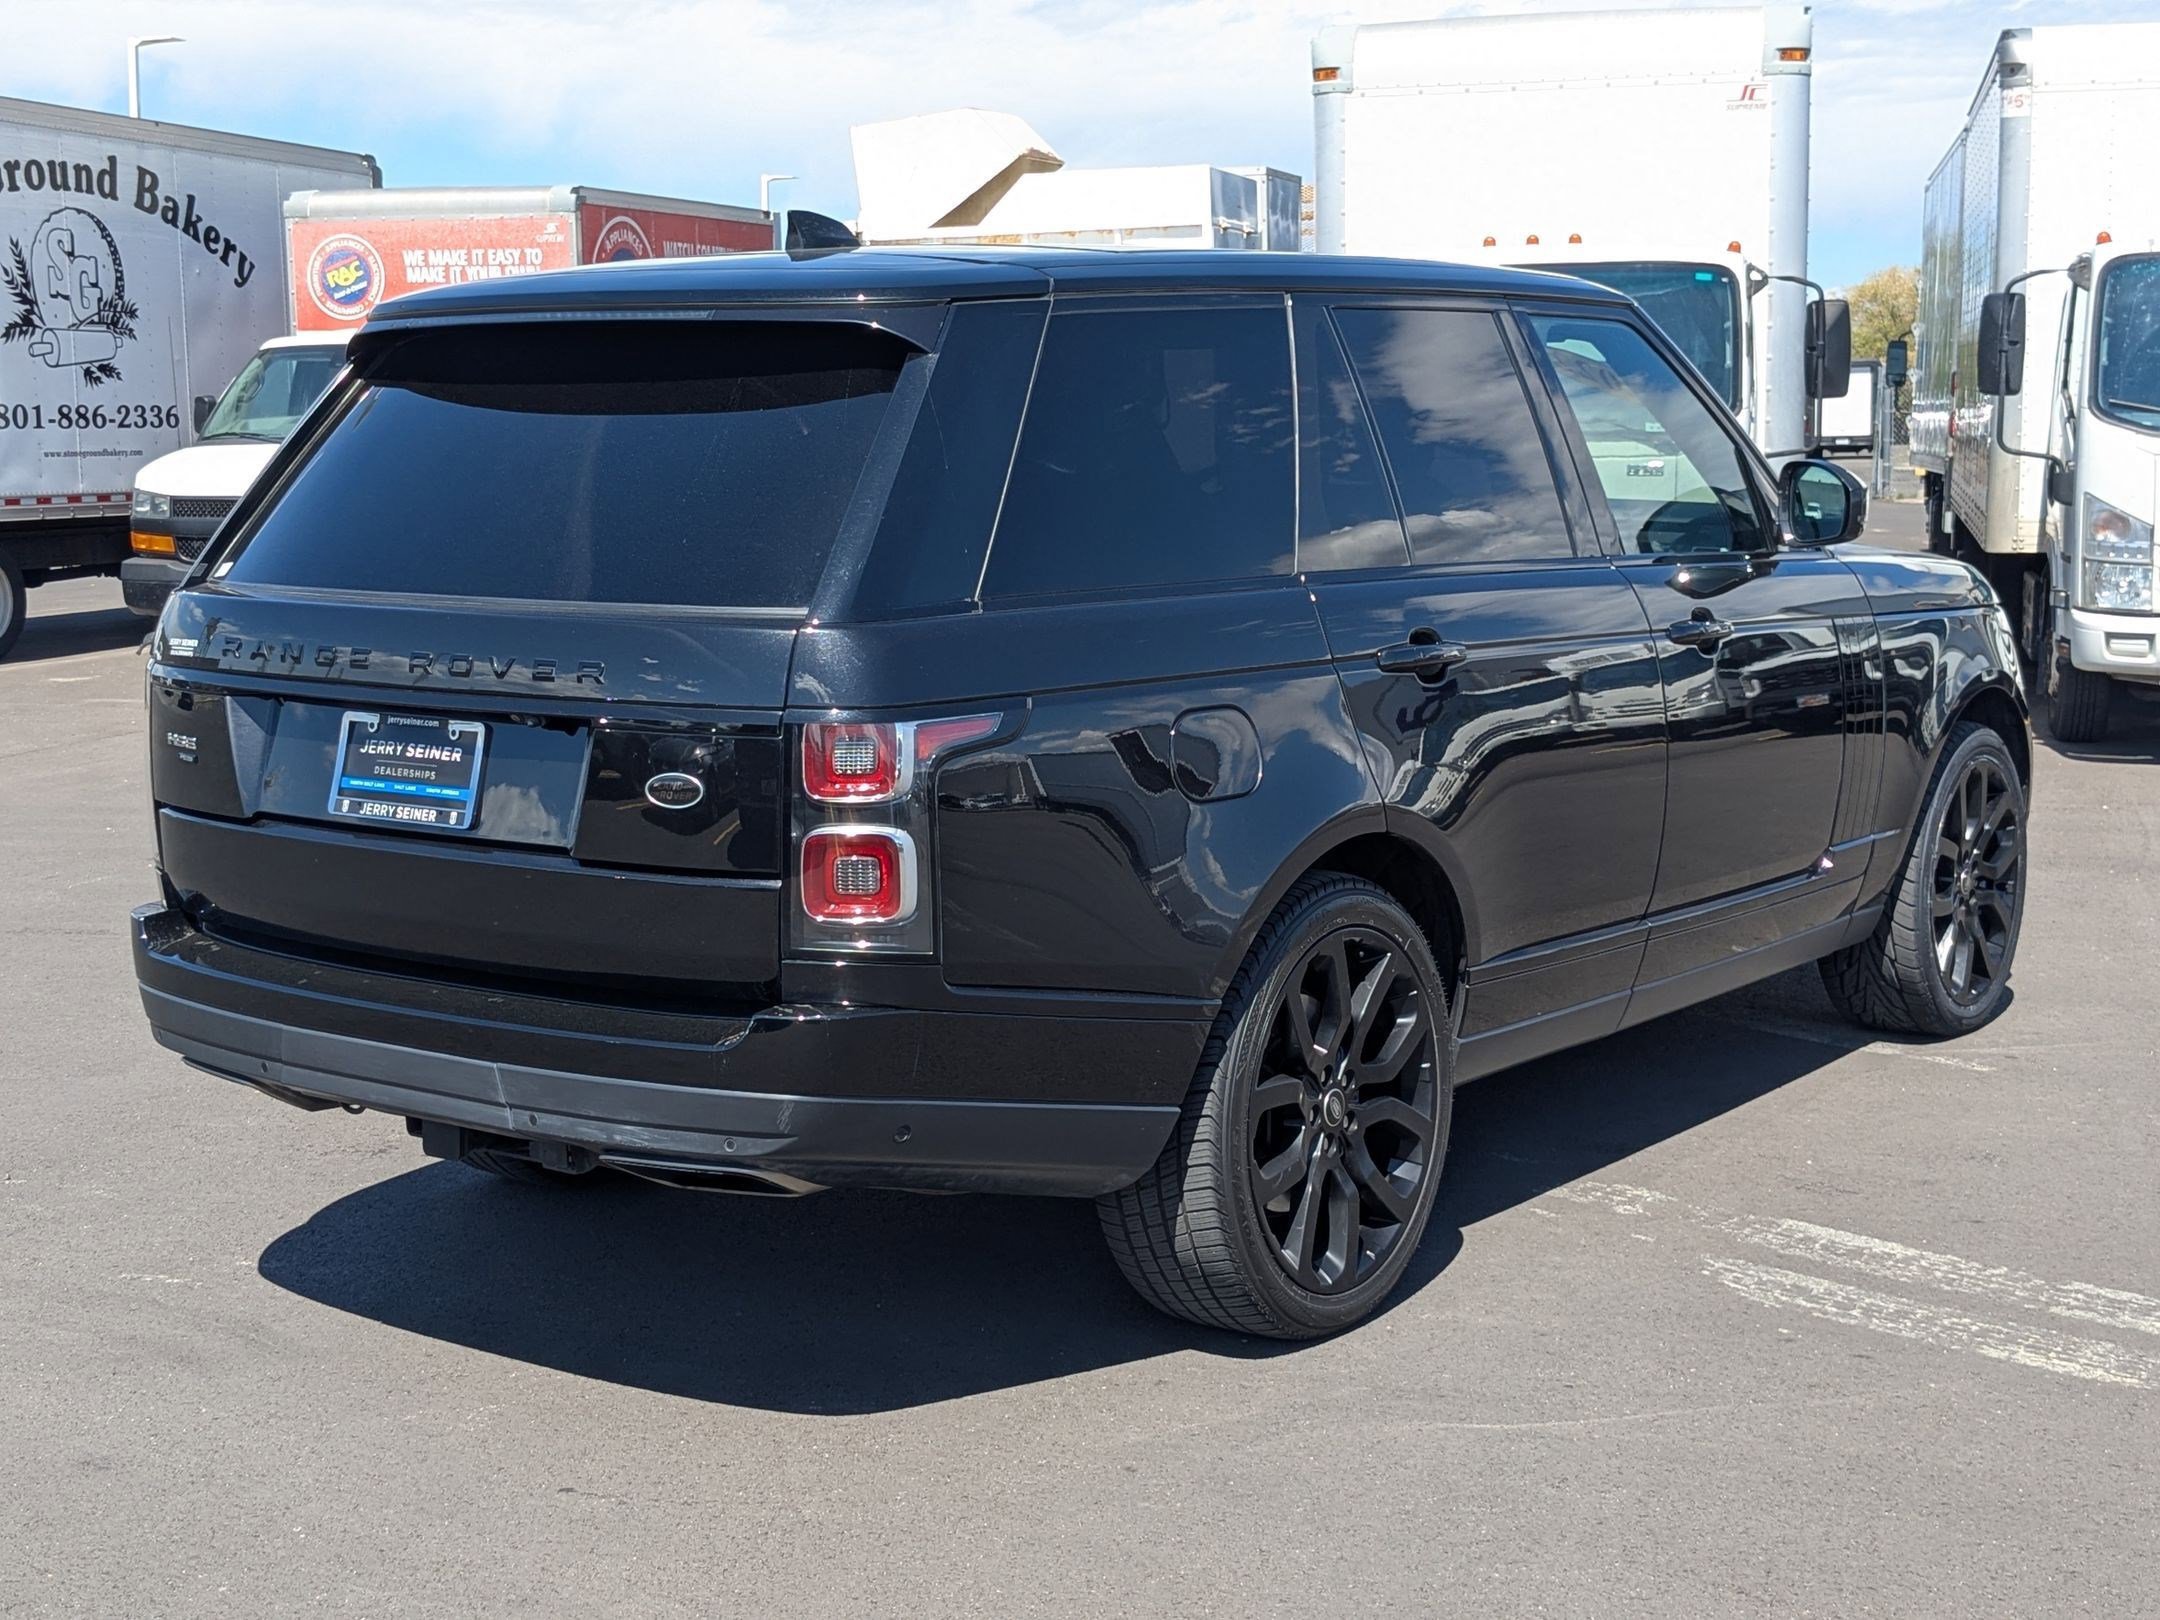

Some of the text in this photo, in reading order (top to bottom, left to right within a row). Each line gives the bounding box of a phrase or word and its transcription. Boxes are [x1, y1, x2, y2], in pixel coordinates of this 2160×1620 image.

[0, 155, 256, 288] round Bakery
[606, 228, 643, 256] APPLIANCES
[403, 247, 543, 266] WE MAKE IT EASY TO
[326, 260, 365, 288] RAC
[406, 266, 446, 284] MAKE
[450, 266, 462, 284] IT
[465, 266, 502, 281] YOUR
[0, 403, 181, 431] 801-886-2336
[44, 448, 143, 459] www.stonegroundbakery.com
[221, 636, 607, 685] RANGE ROVER
[387, 715, 440, 727] jerryseiner.com
[360, 739, 462, 762] JERRY SEINER
[374, 765, 436, 780] DEALERSHIPS
[359, 801, 397, 818] JERRY
[395, 806, 437, 822] SEINER
